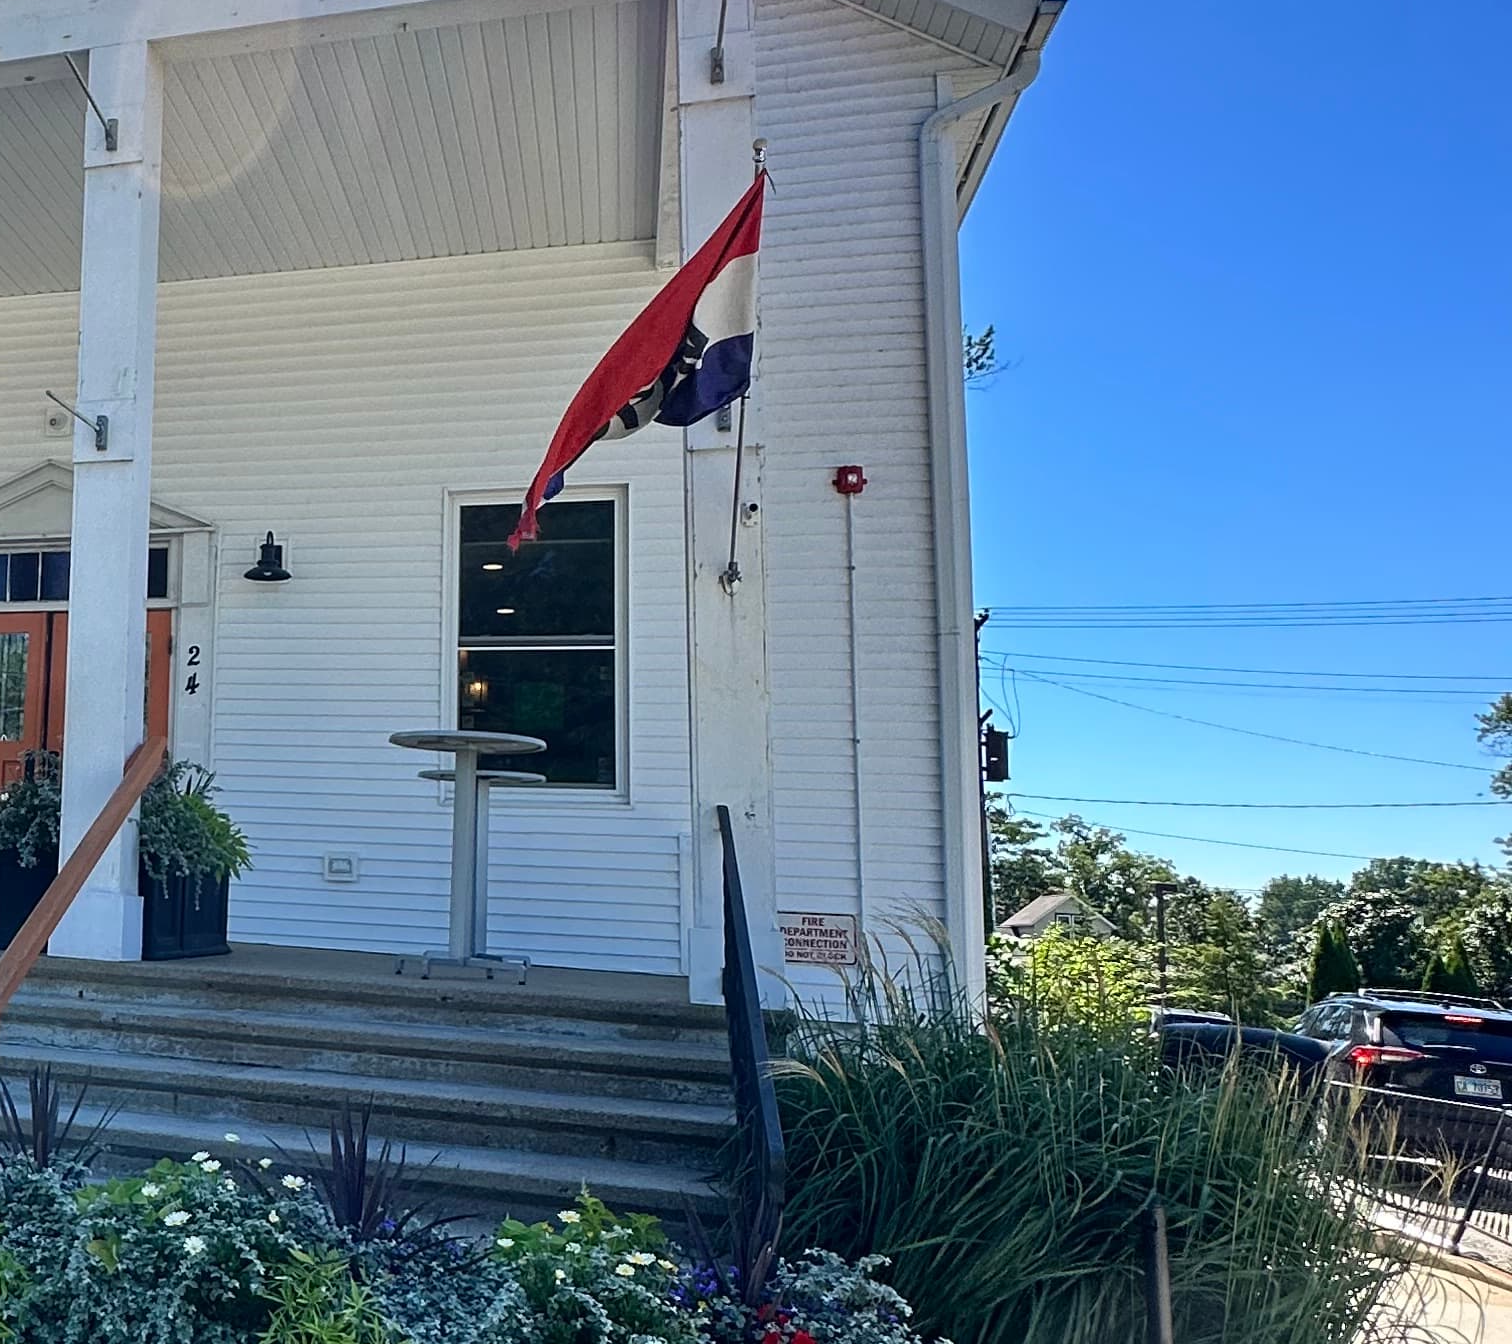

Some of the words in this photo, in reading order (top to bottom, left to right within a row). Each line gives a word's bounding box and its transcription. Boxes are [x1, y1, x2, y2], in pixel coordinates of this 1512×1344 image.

[184, 645, 200, 695] 24
[802, 917, 825, 926] FIRE
[797, 951, 813, 960] NOT
